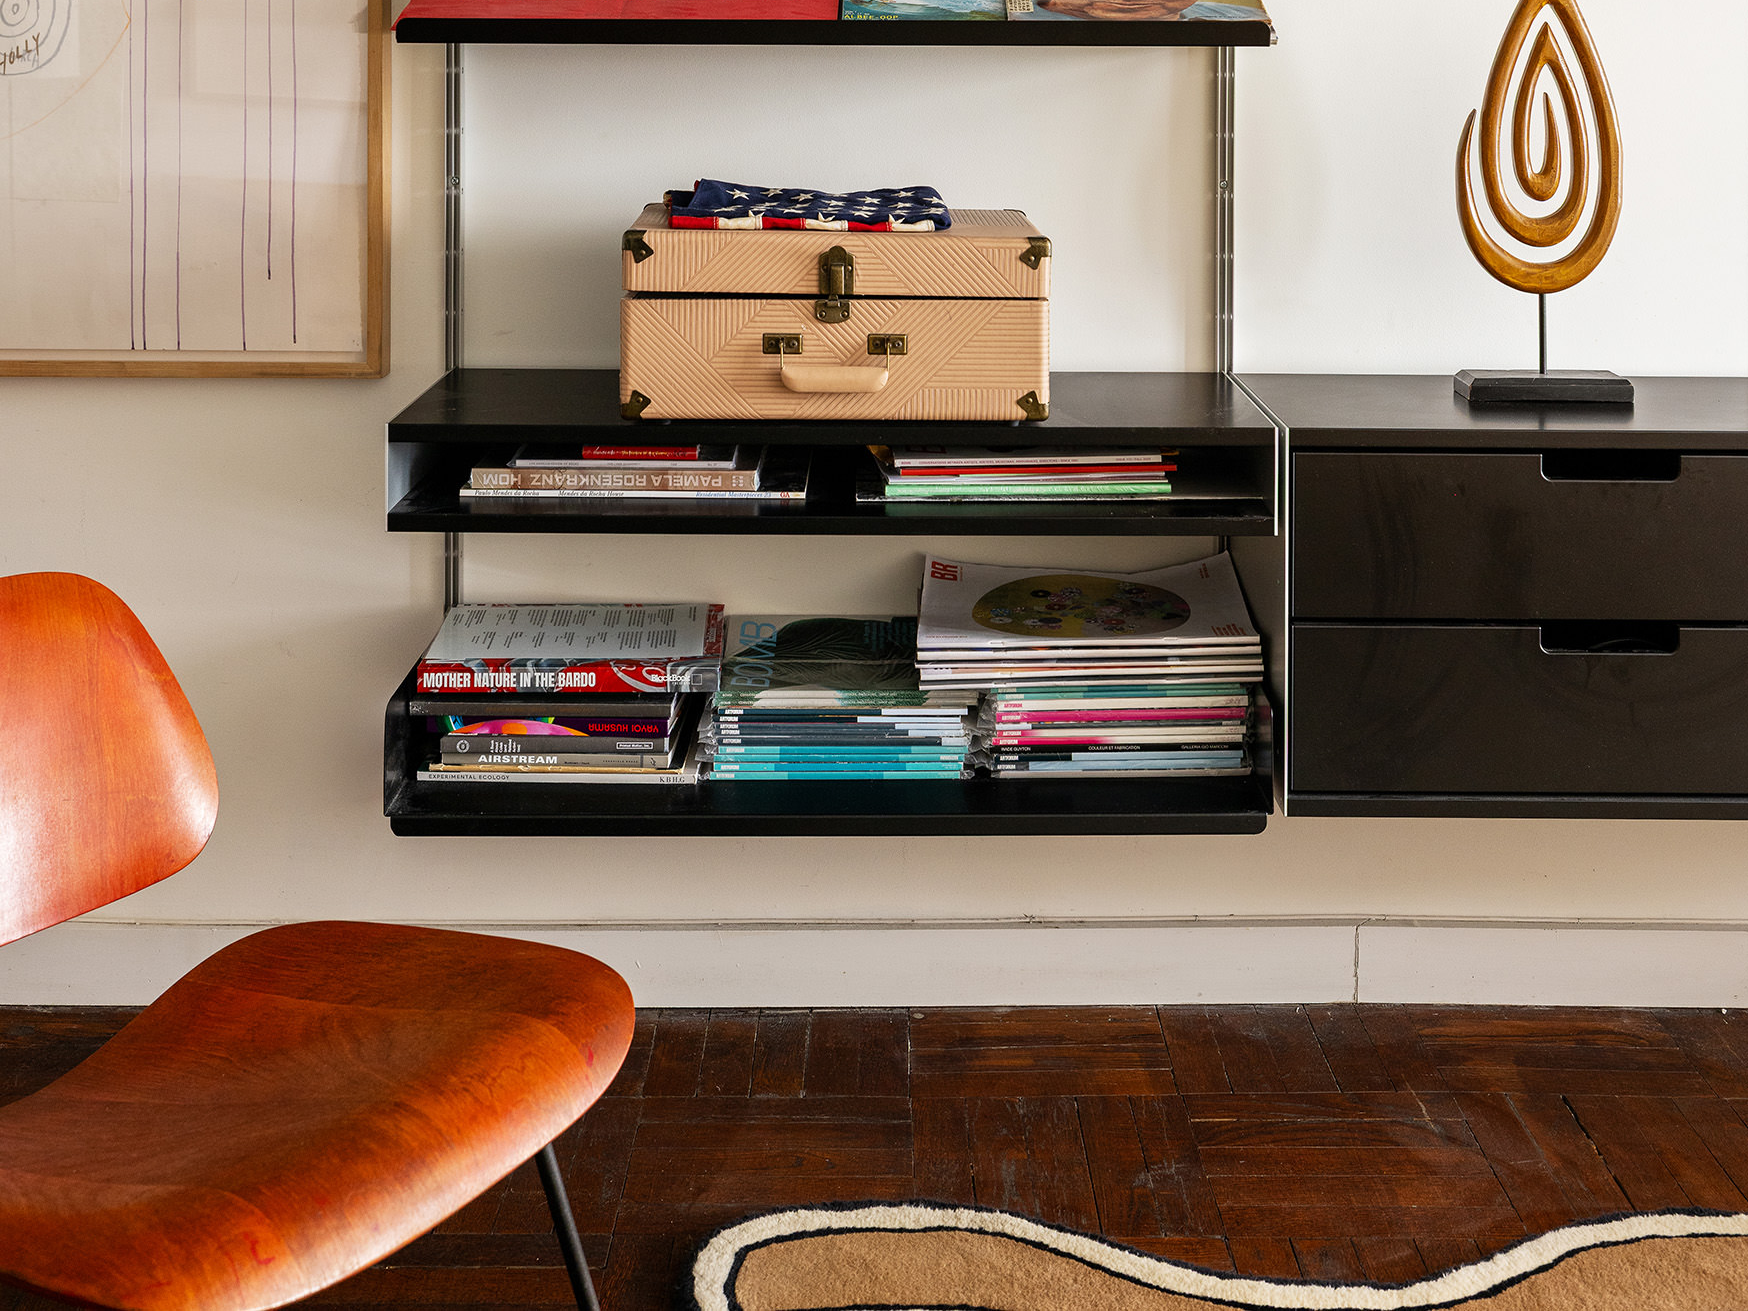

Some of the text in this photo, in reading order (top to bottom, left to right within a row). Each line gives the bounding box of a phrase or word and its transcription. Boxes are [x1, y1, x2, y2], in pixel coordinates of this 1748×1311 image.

[530, 473, 646, 486] ROSENKRANZ
[654, 474, 722, 486] PAMELA
[931, 560, 958, 582] BR
[731, 621, 777, 688] BOMB
[424, 673, 596, 688] MOTHER NATURE IN THE BARDO
[588, 723, 659, 733] YAYOI KUSAMA
[478, 755, 558, 764] AIRSTREAM
